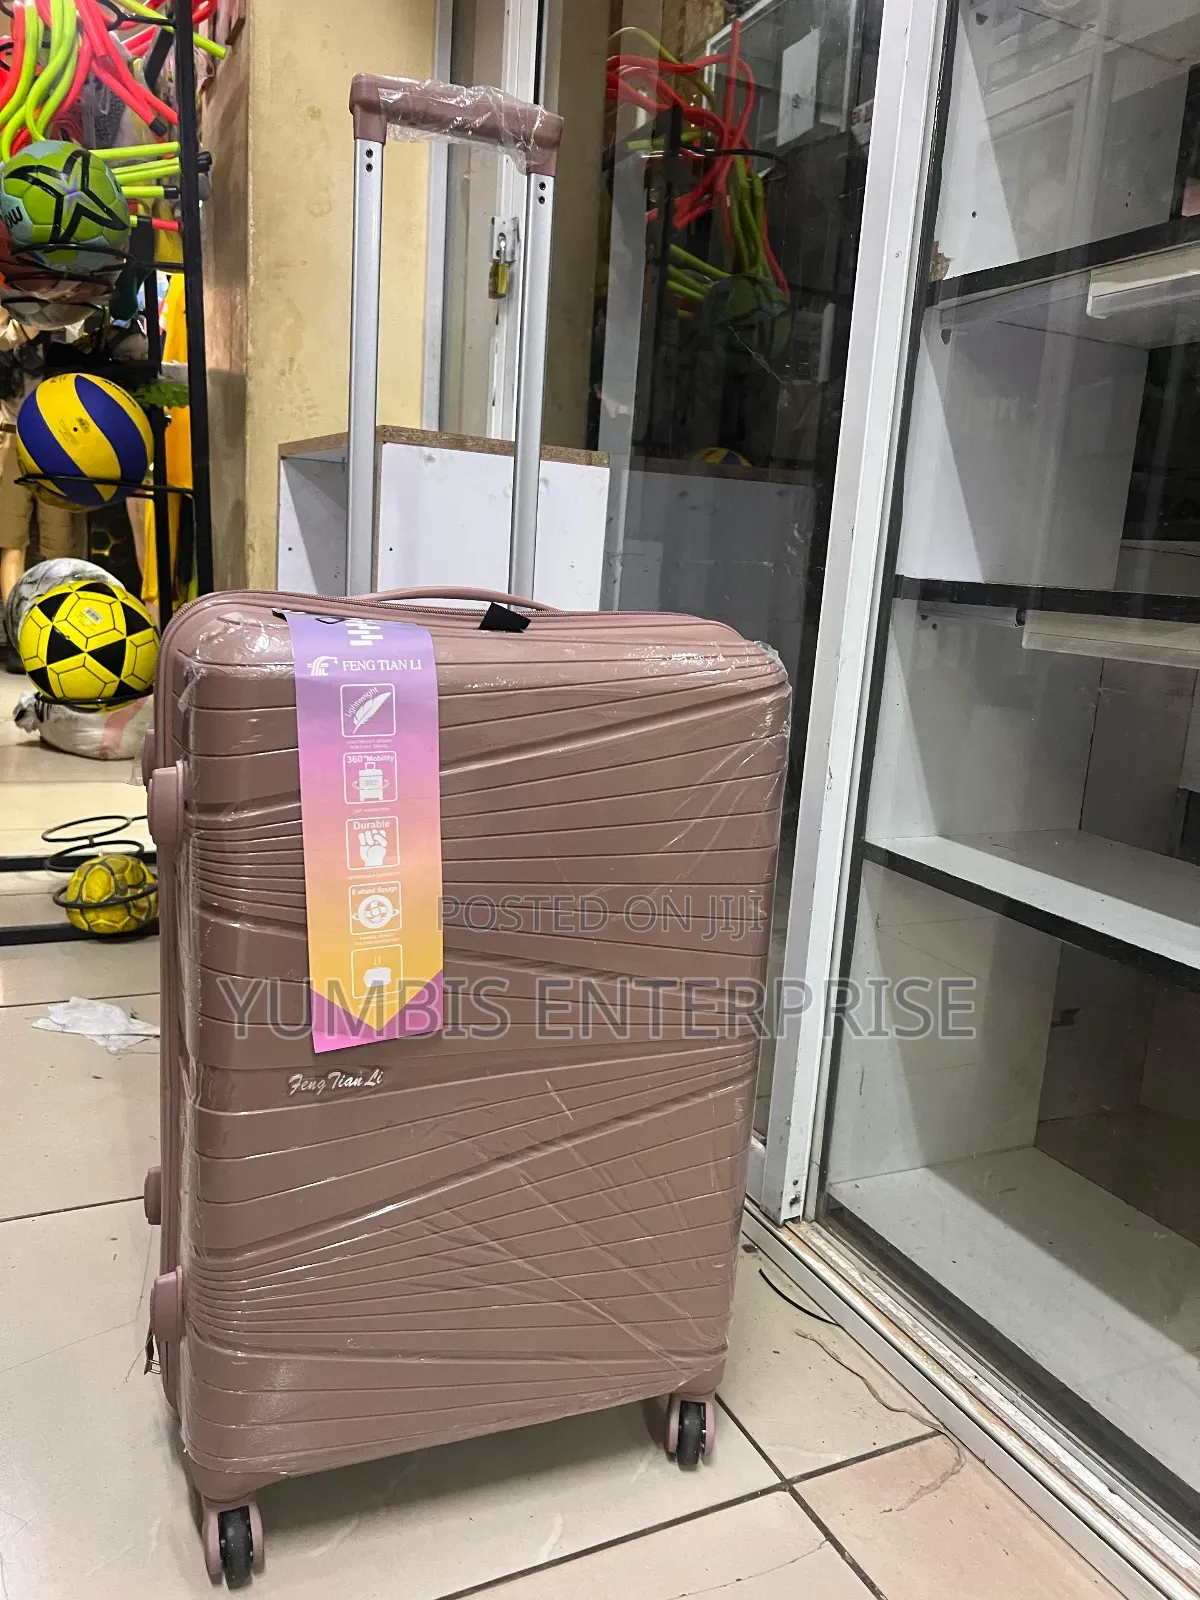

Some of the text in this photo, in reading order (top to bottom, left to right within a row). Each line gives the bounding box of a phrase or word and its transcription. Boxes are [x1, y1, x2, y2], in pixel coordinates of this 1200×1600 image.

[342, 659, 423, 672] FENG TIAN LI
[344, 686, 380, 718] Lightweight
[353, 820, 390, 830] Durable
[357, 886, 376, 895] wheel
[376, 885, 399, 894] design
[288, 1068, 384, 1096] Feng Tian Li
